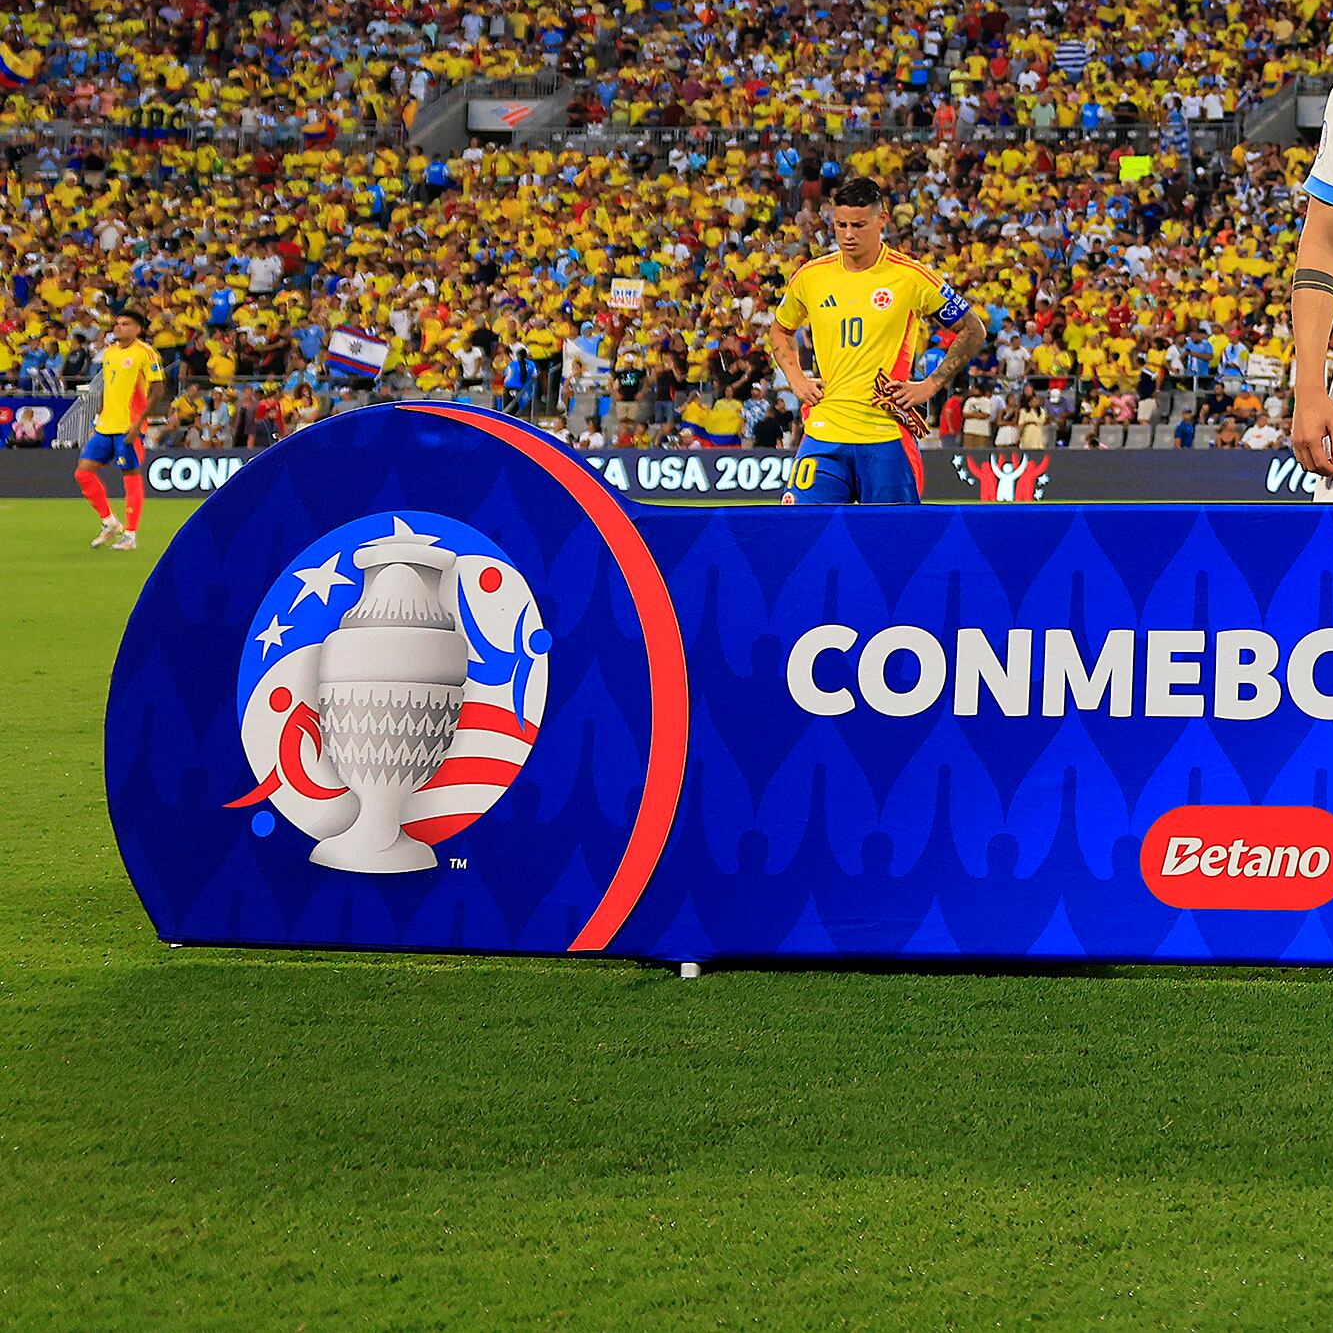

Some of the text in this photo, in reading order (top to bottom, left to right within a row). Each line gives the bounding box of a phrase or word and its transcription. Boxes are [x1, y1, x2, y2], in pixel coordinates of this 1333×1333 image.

[840, 317, 863, 348] 10
[637, 455, 711, 493] USA
[787, 457, 818, 490] 10
[1161, 835, 1331, 880] Betano
